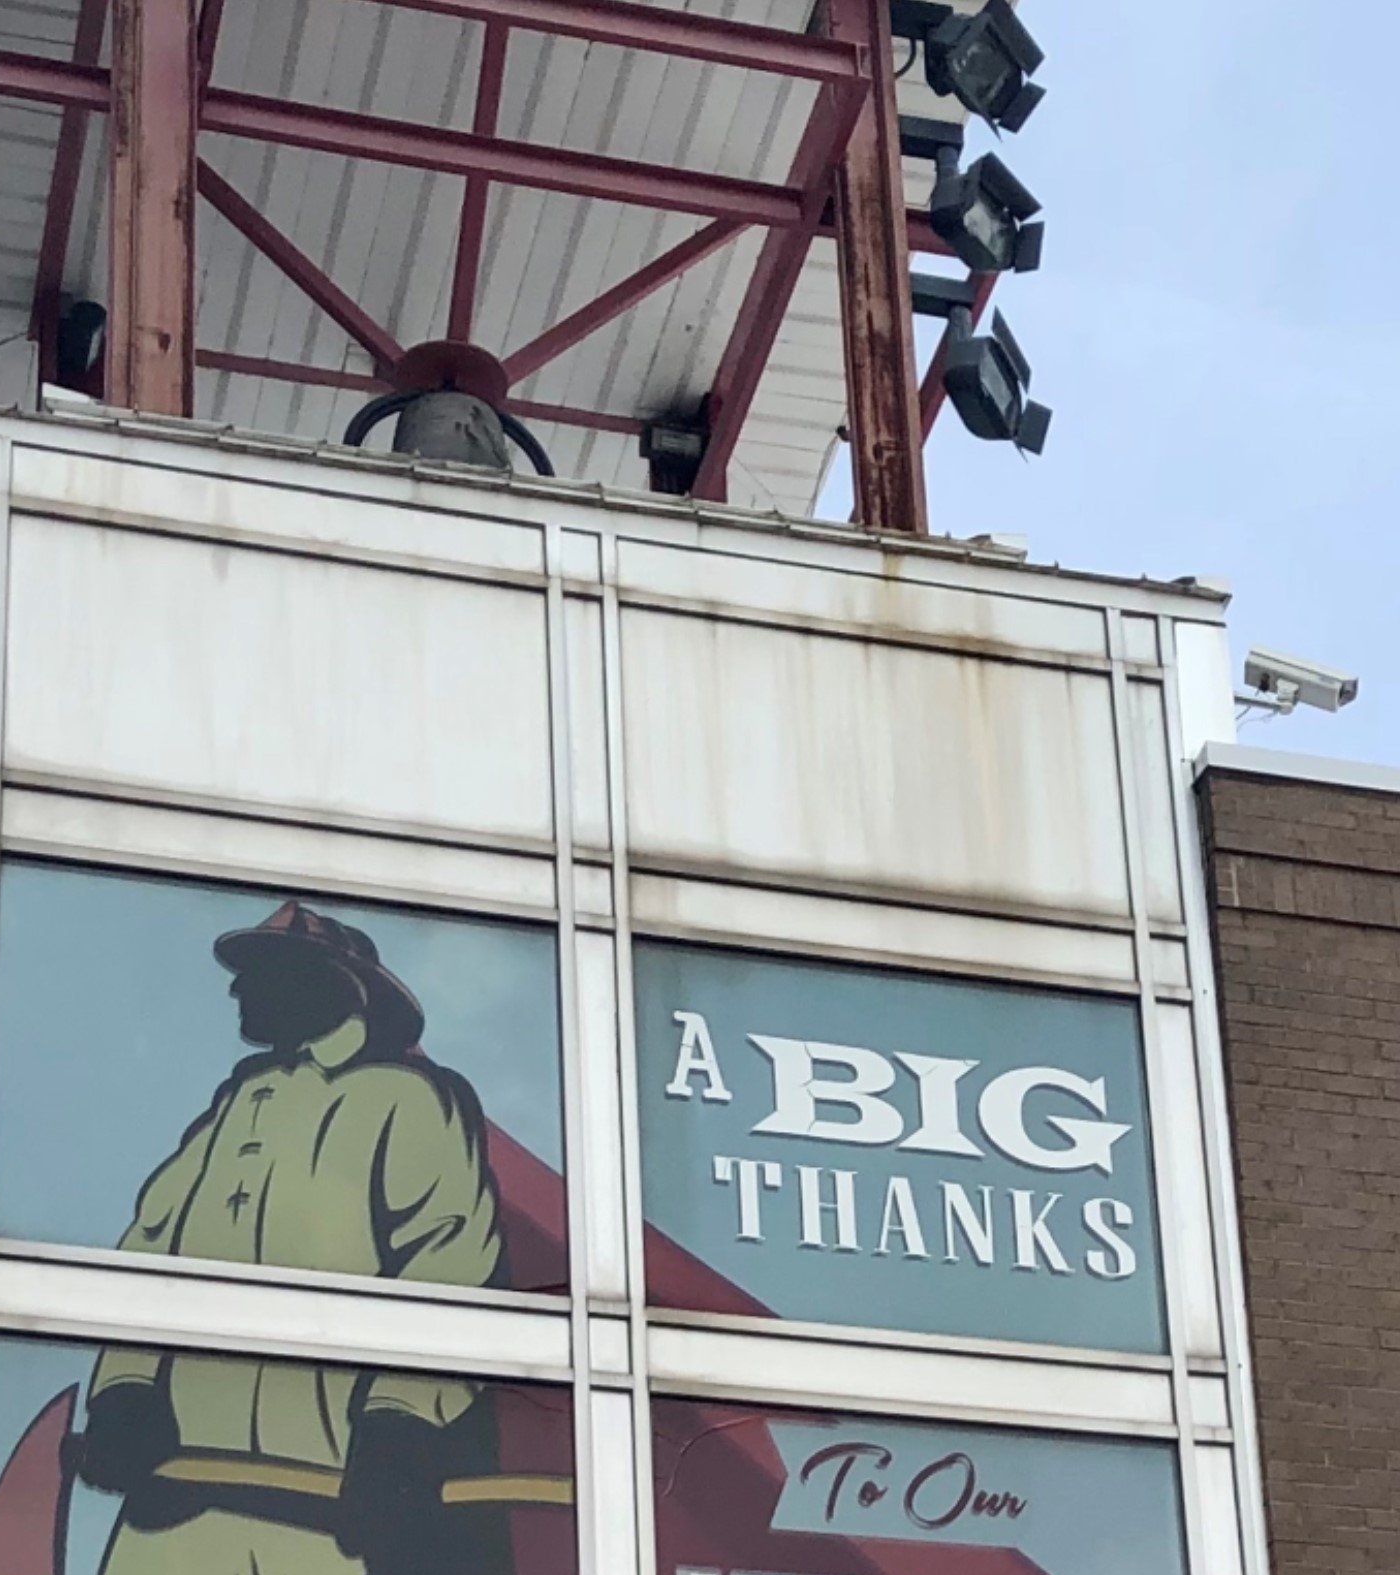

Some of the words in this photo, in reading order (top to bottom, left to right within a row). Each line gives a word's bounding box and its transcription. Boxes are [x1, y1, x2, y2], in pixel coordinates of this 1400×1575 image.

[665, 1010, 732, 1102] A
[746, 1032, 1133, 1174] BIG
[712, 1155, 1137, 1280] THANKS
[800, 1442, 893, 1522] To
[903, 1451, 1028, 1530] Our
